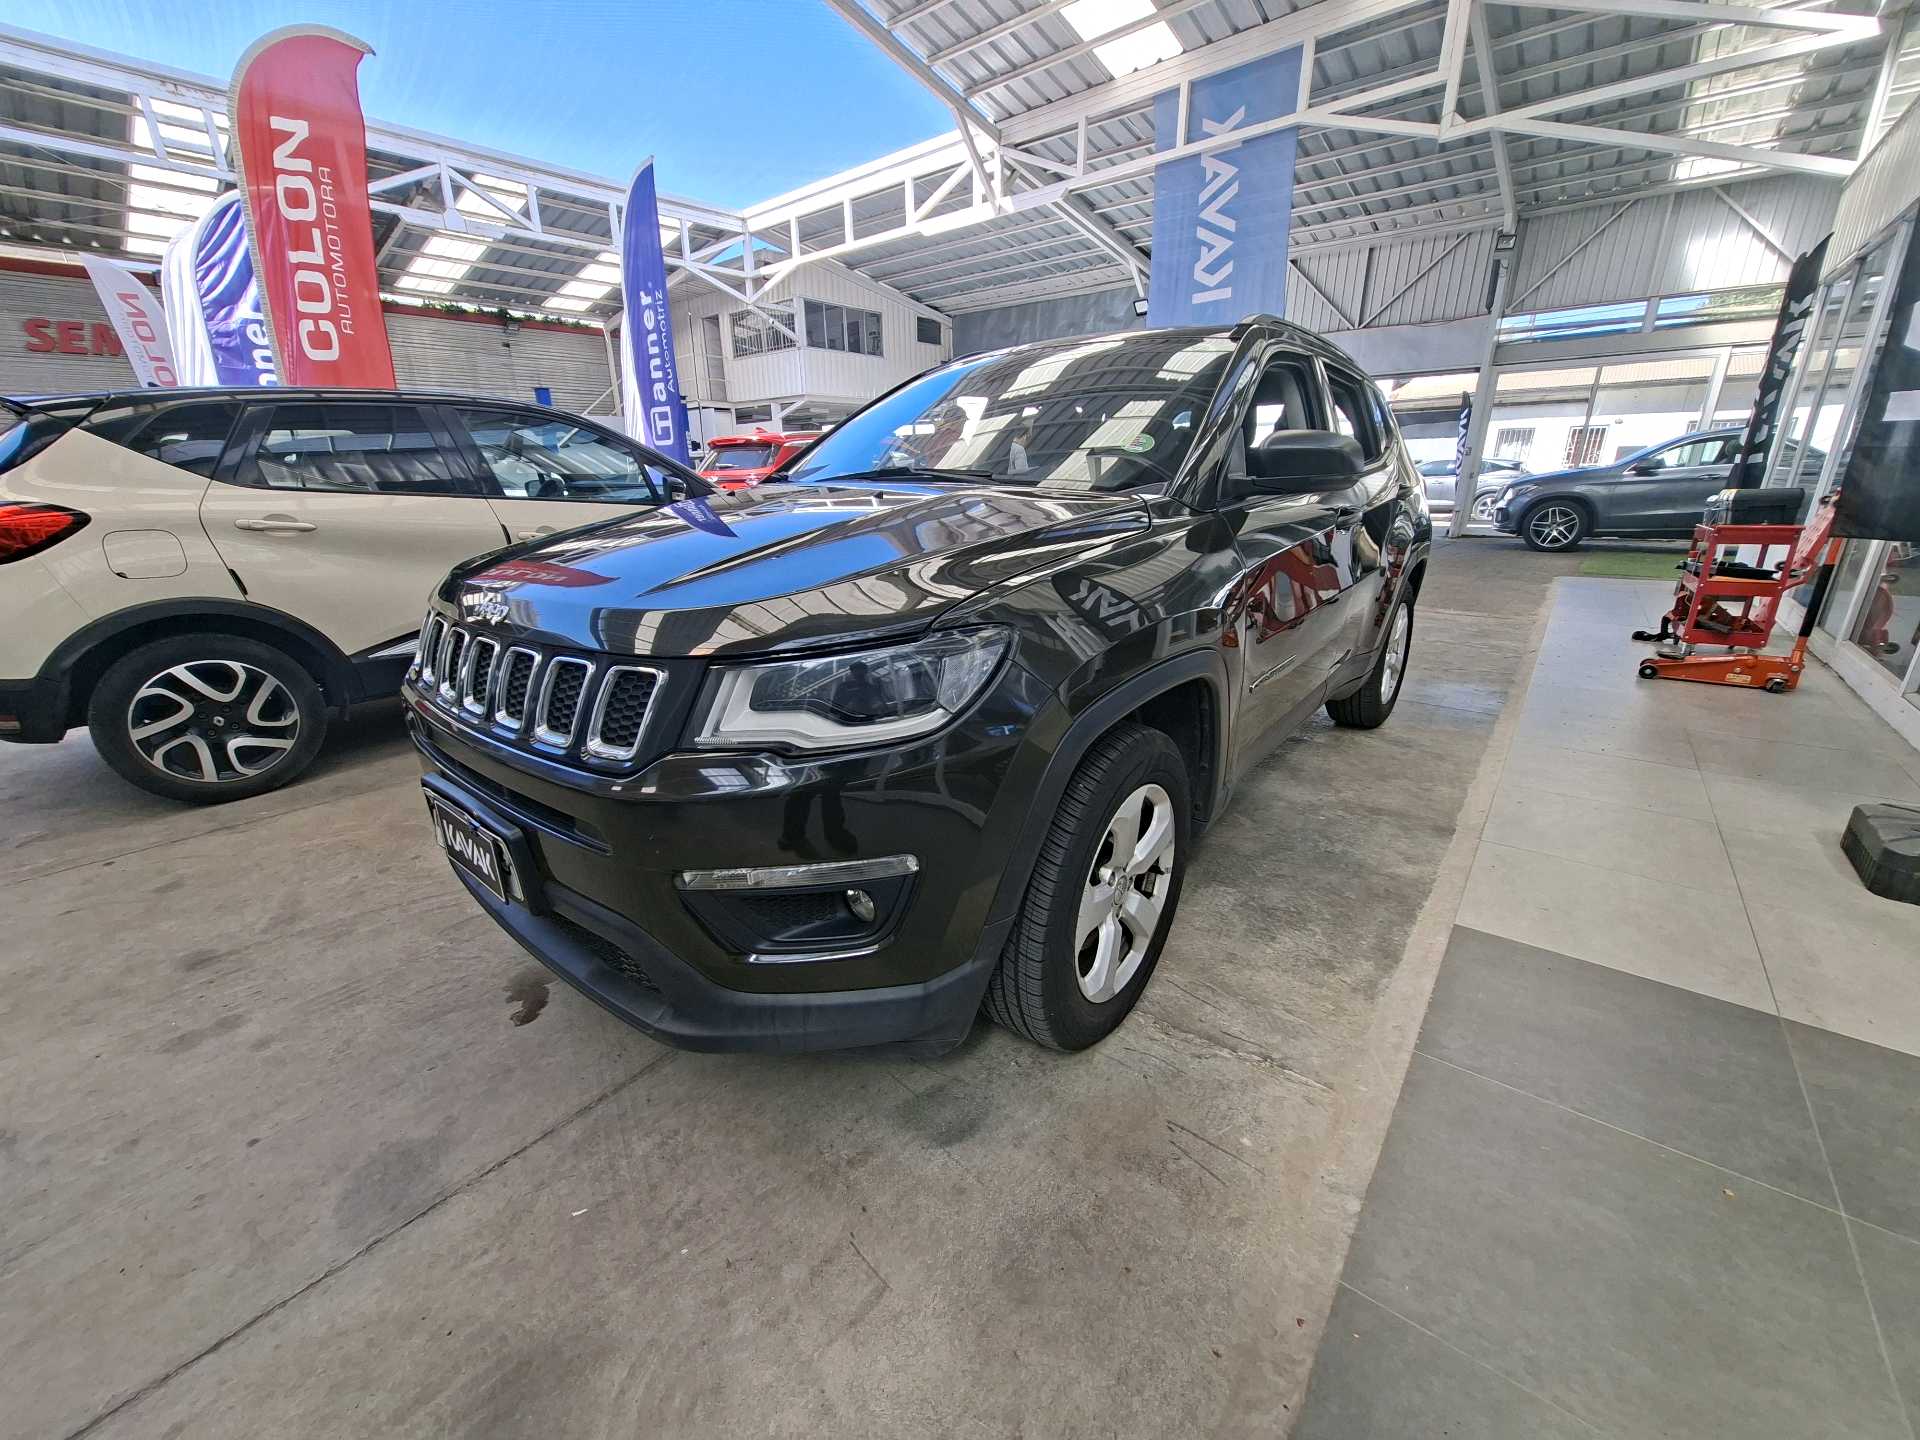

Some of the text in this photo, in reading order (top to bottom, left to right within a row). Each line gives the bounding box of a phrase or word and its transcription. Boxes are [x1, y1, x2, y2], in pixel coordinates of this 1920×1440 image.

[269, 115, 340, 361] COLON
[319, 166, 354, 335] AUTOMOTORA
[1192, 105, 1246, 304] KAVAK
[654, 288, 675, 393] Automotriz
[442, 818, 497, 883] KAVAK
